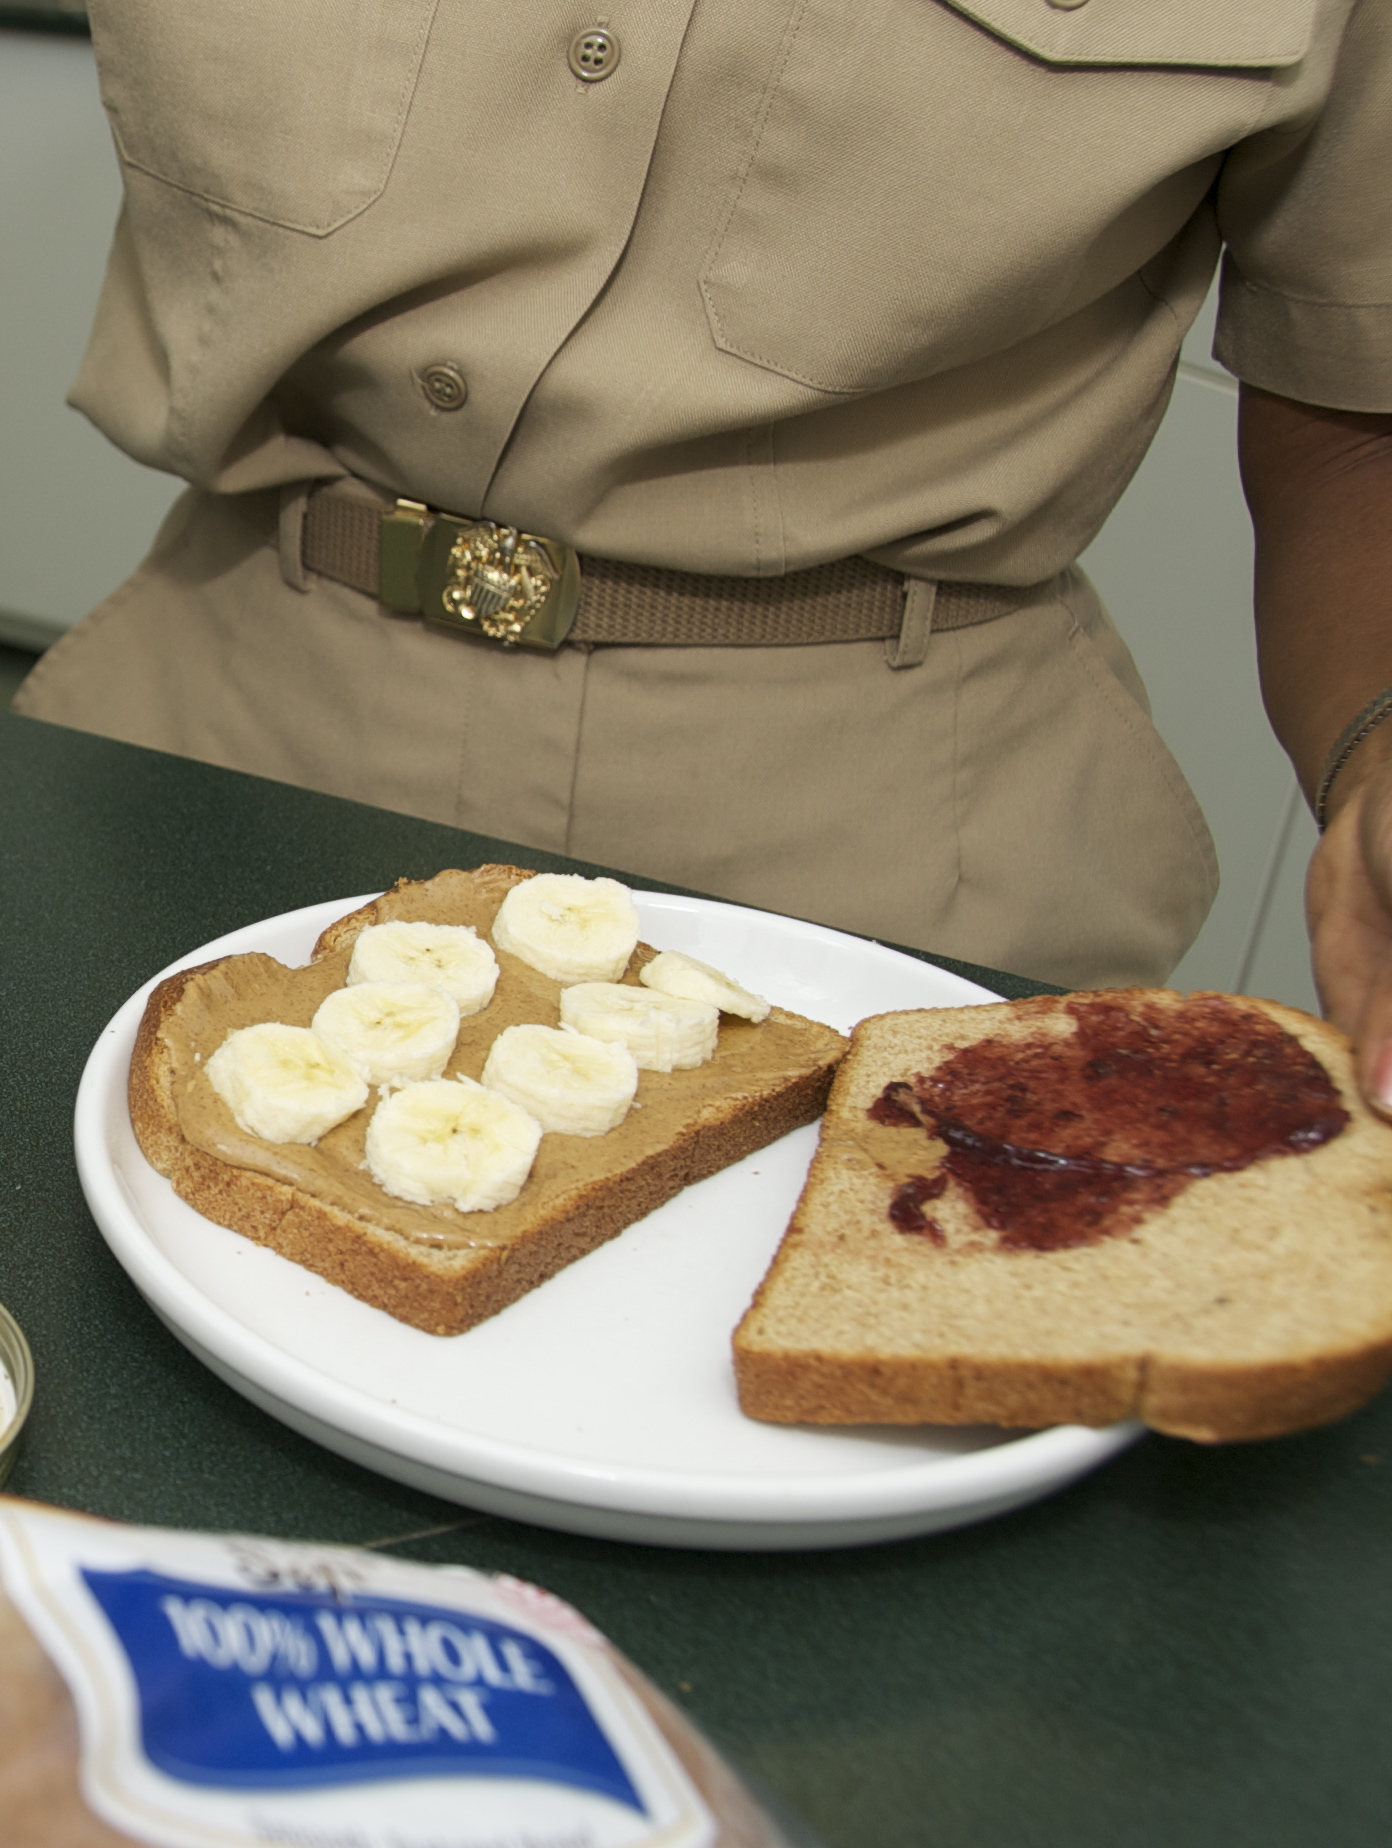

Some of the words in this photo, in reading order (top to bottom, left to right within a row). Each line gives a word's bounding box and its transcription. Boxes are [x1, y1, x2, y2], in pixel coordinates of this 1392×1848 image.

[164, 1596, 319, 1679] 100%
[315, 1608, 556, 1695] WHOLE
[251, 1681, 497, 1752] WHEAT
